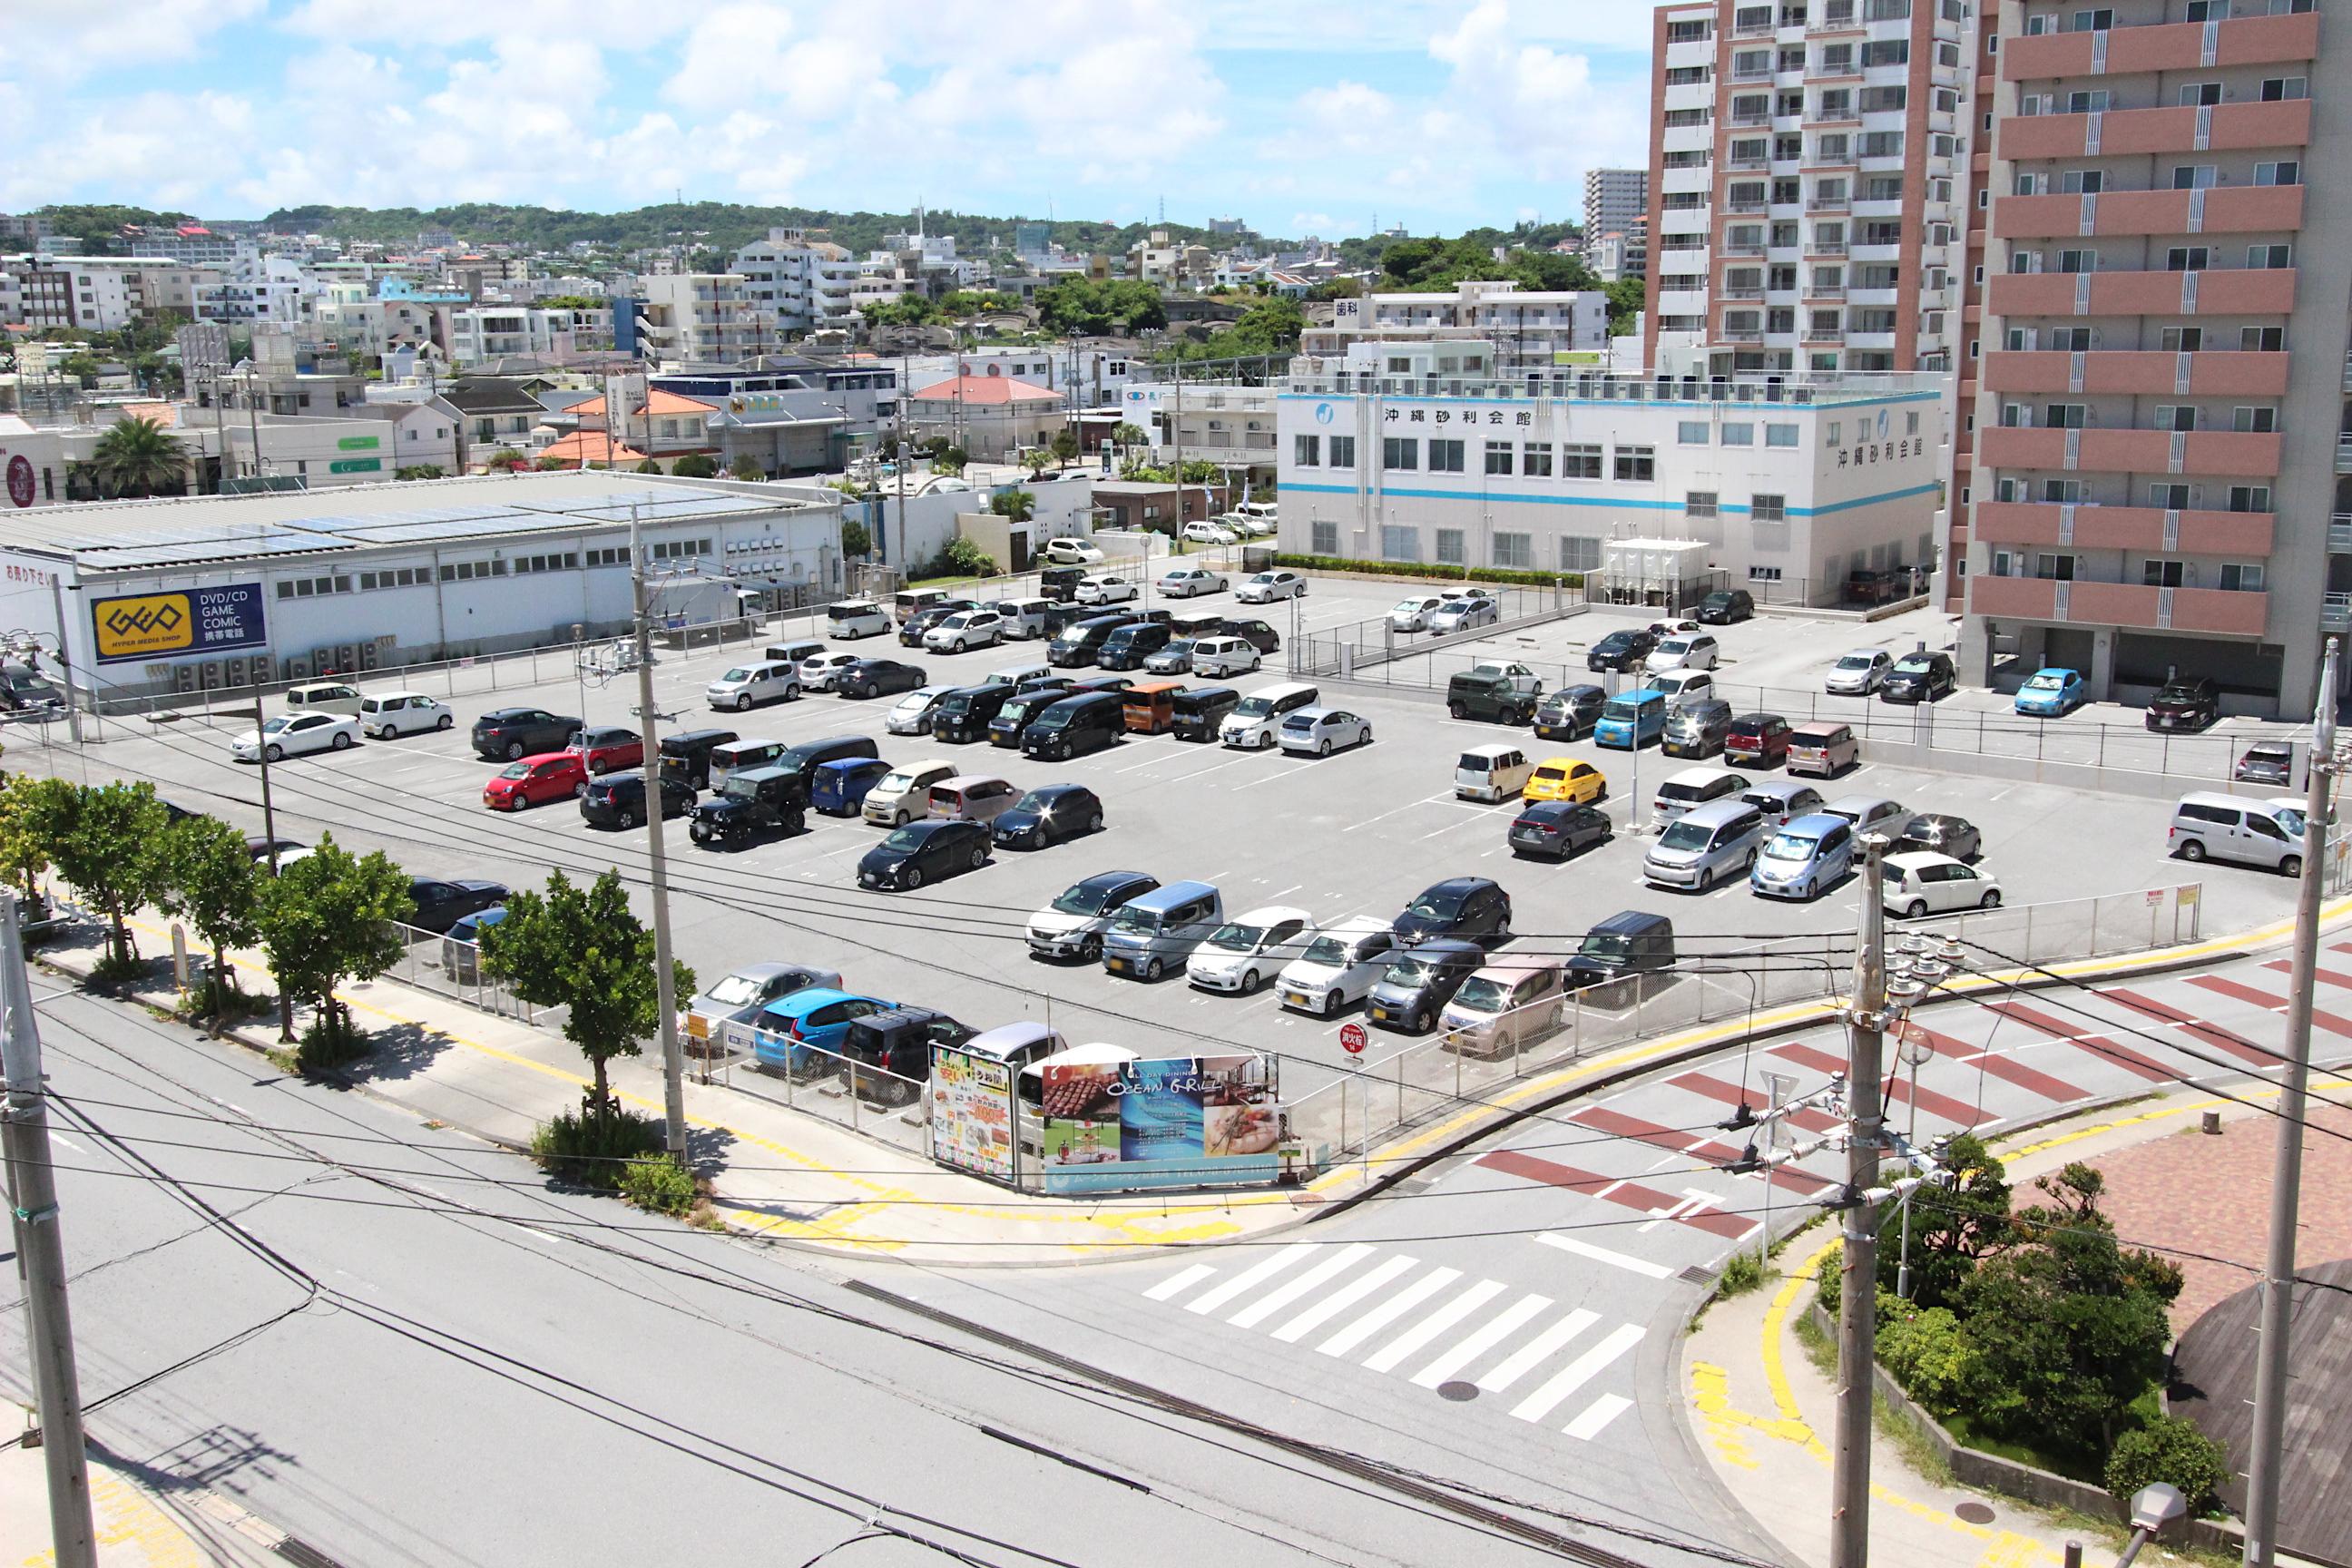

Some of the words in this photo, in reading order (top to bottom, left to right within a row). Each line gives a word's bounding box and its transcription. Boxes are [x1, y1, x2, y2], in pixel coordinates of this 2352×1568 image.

[1337, 302, 1357, 316] 歯科
[1385, 408, 1531, 426] 沖縄砂利会館
[201, 591, 248, 605] DVD/CD
[201, 604, 235, 617] GAME
[105, 603, 183, 636] GEO
[203, 615, 241, 630] COMIC
[112, 639, 136, 648] HYPER
[137, 637, 160, 645] MEDIA
[162, 634, 181, 643] SHOP
[204, 627, 245, 642] 携帯電話
[1106, 1080, 1163, 1096] OCEAN
[1170, 1078, 1222, 1093] GRILL
